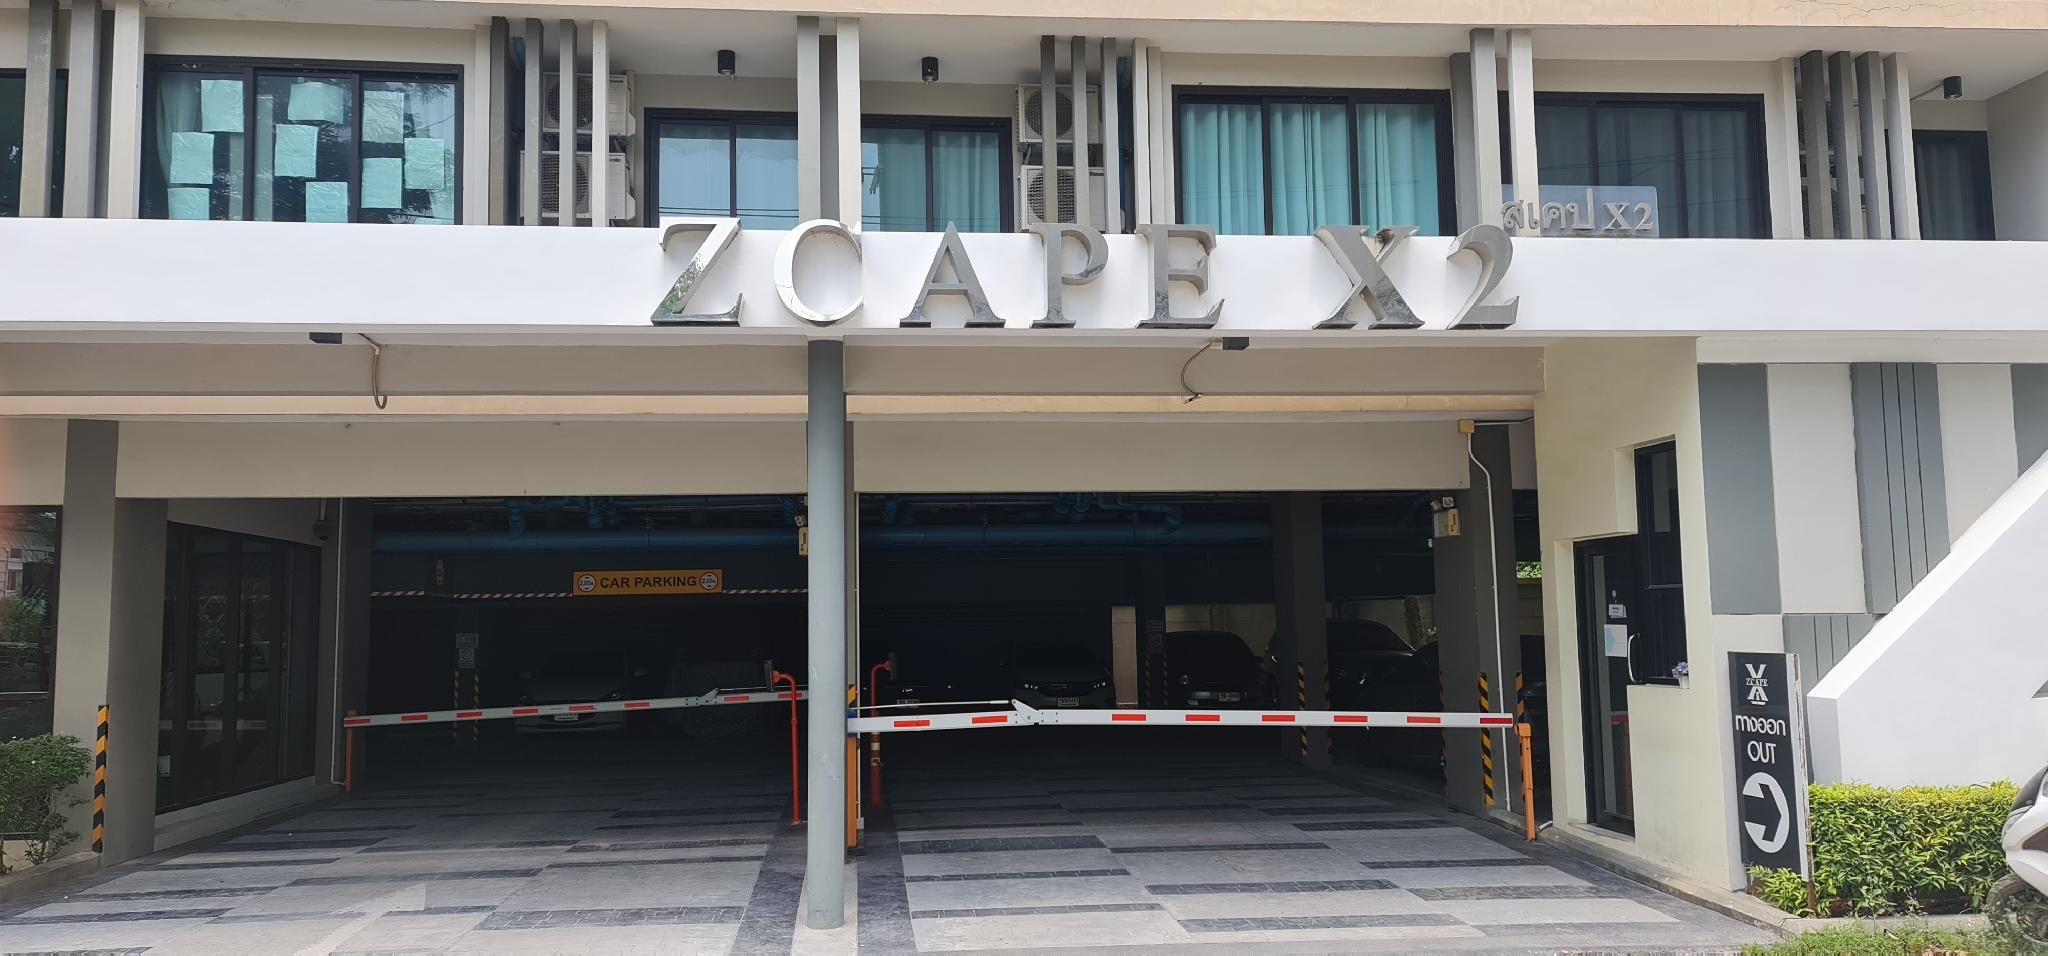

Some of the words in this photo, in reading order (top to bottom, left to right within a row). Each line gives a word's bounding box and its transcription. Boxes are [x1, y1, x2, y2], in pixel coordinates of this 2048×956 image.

[1501, 188, 1596, 231] สเคป
[1602, 202, 1655, 231] X2
[650, 216, 1226, 330] ZCAPE
[1312, 224, 1520, 330] X2
[600, 577, 630, 589] CAR
[634, 576, 697, 588] PARKING
[1745, 678, 1769, 687] ZCAPE
[1735, 714, 1787, 736] ทางออก
[1747, 740, 1777, 764] OUT
